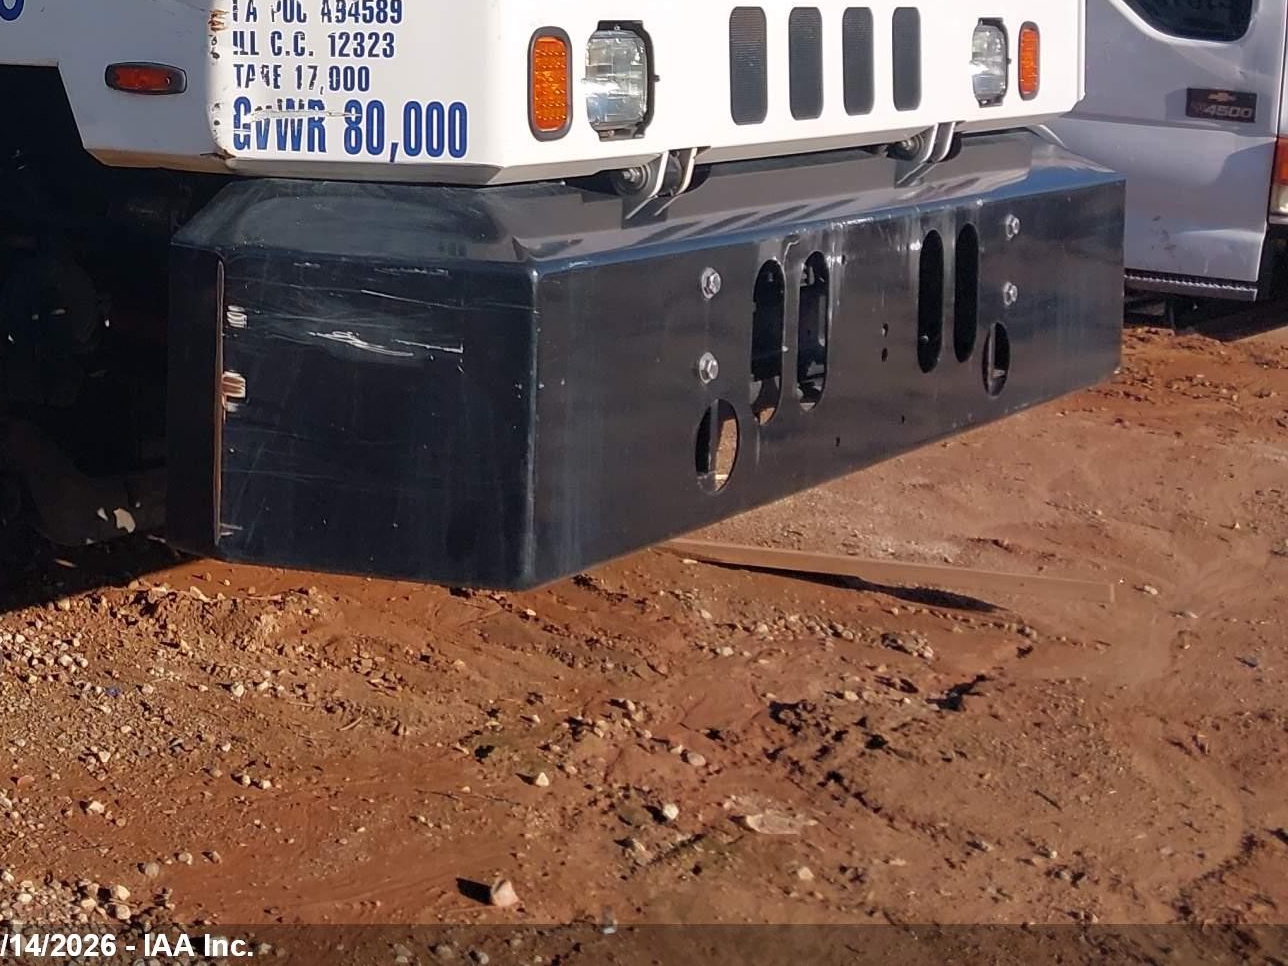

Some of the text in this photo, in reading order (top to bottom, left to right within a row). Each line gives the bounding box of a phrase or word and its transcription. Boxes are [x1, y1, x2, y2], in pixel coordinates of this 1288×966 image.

[270, 30, 314, 57] C.C.
[327, 32, 395, 58] 12323
[295, 64, 370, 96] 17,000
[233, 96, 468, 164] GVWR 80,000
